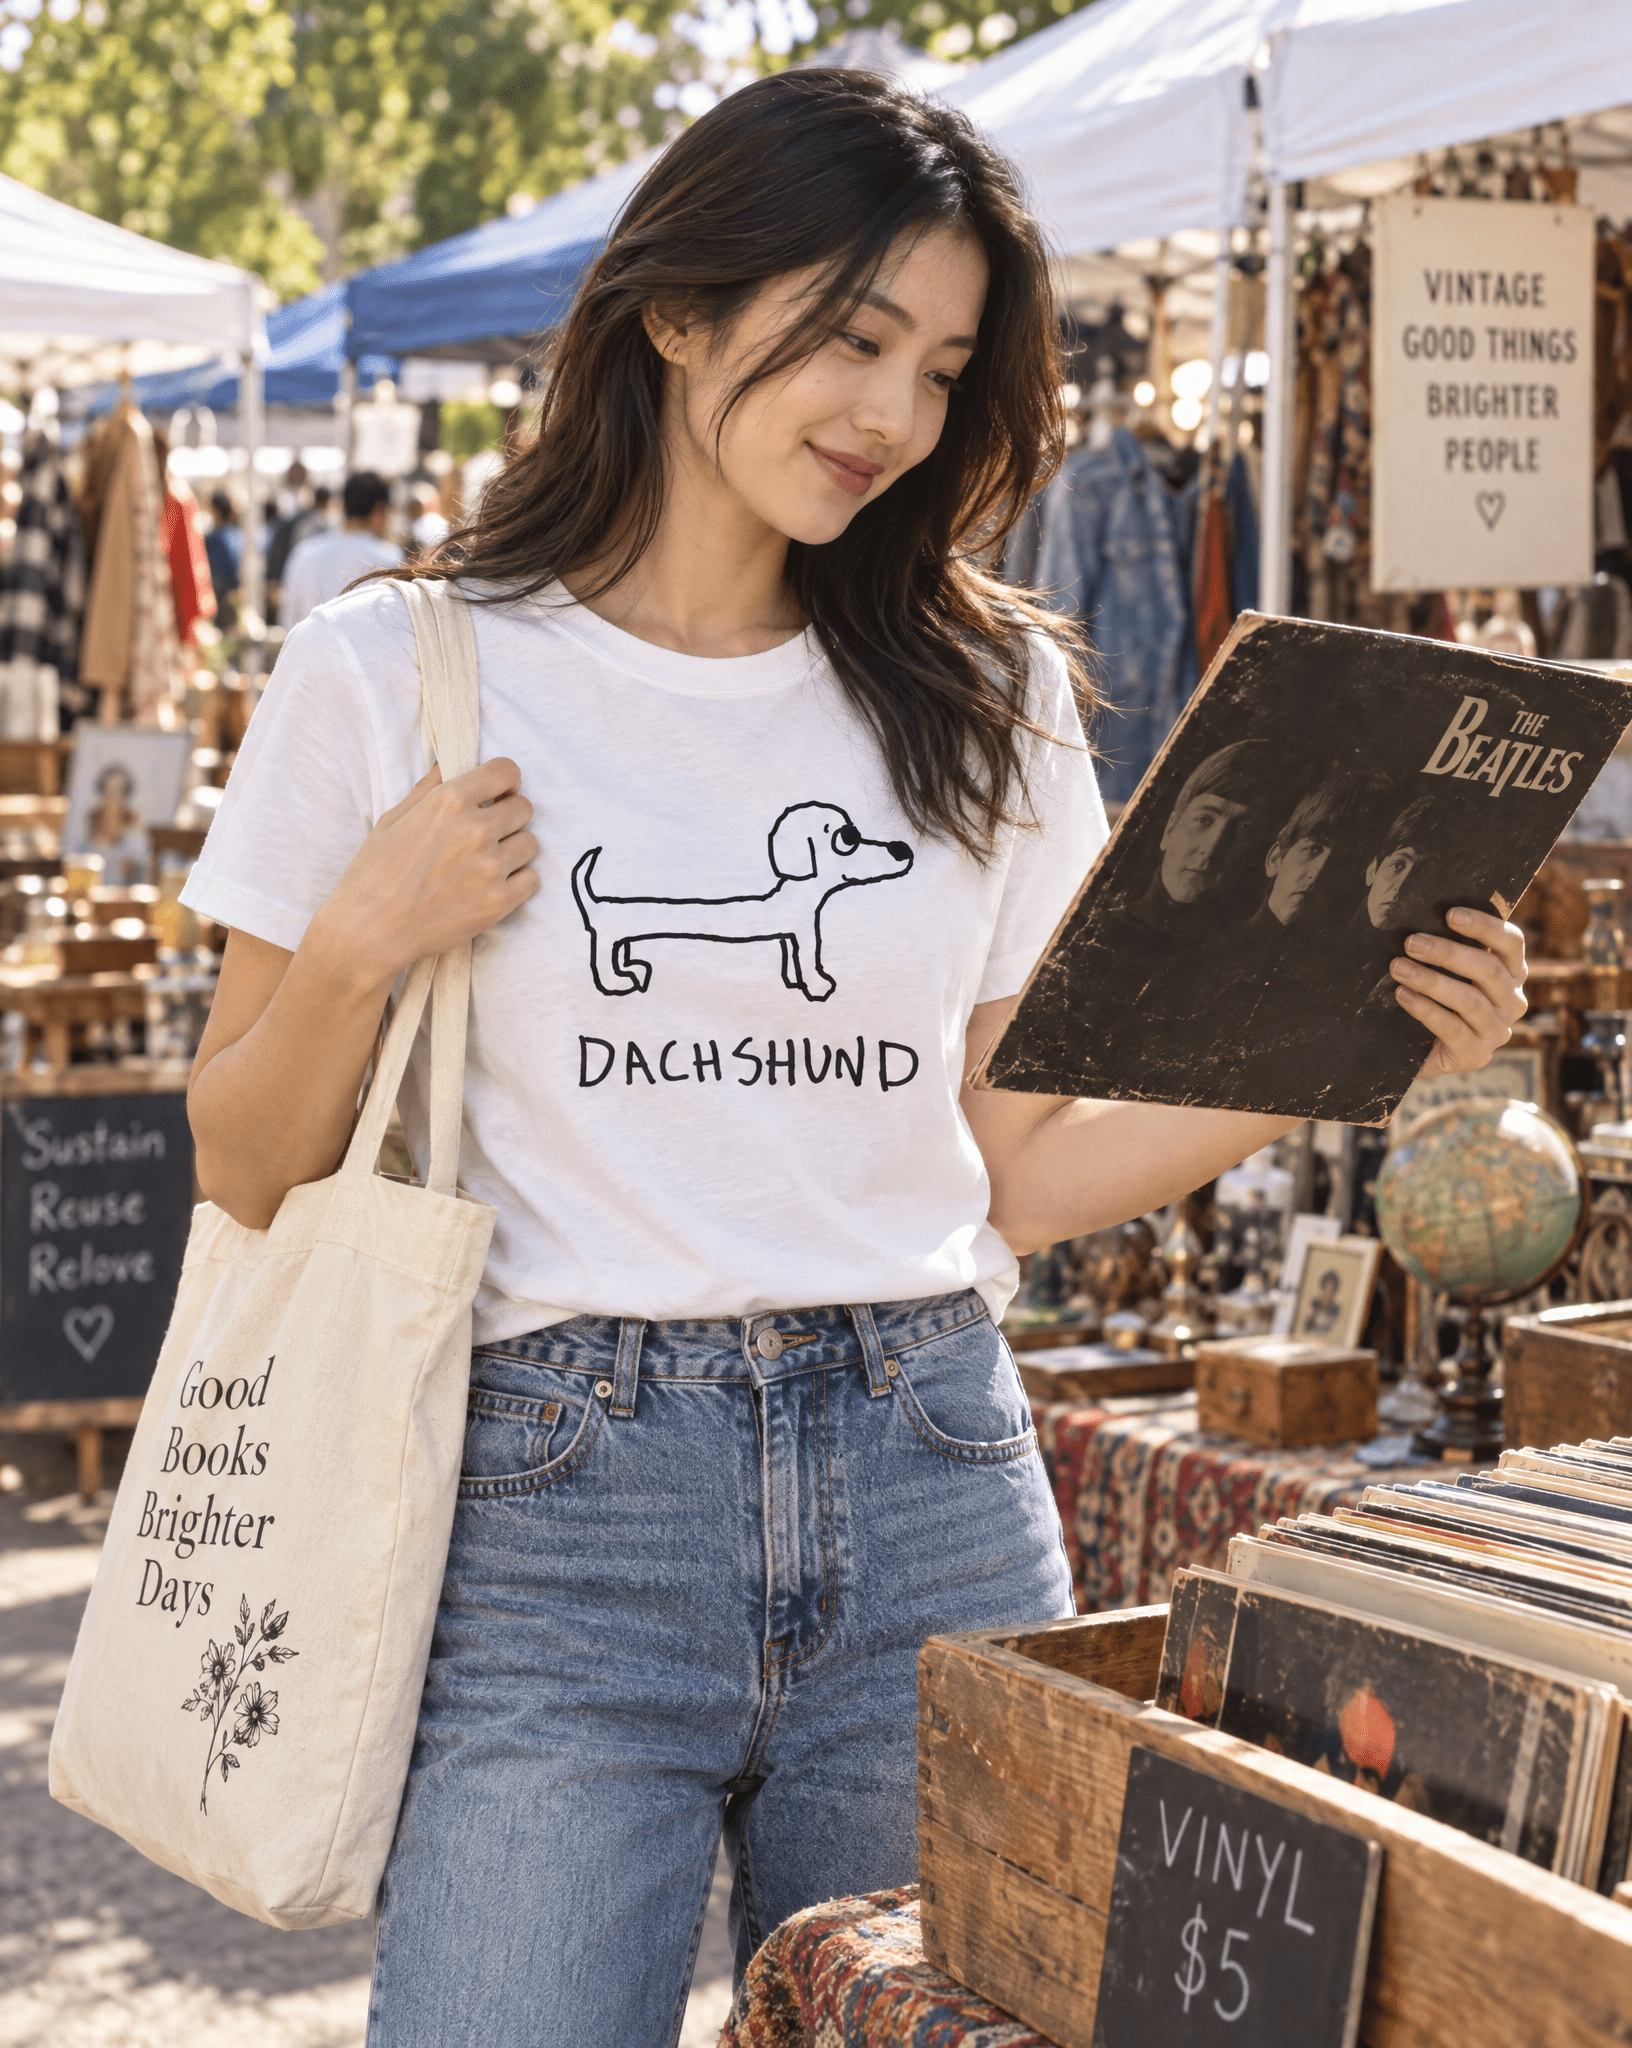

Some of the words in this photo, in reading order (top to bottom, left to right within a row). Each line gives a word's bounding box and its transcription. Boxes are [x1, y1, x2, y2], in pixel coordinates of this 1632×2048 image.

[1424, 270, 1544, 307] VINTAGE
[1402, 324, 1475, 361] GOOD
[1486, 327, 1578, 364] THINGS
[1428, 383, 1559, 419] BRIGHTER
[1446, 437, 1538, 473] PEOPLE
[1420, 695, 1584, 797] BEATLES
[1509, 710, 1550, 737] THE
[579, 1035, 918, 1092] DACHSHUND
[22, 1120, 166, 1170] Sustain
[30, 1181, 144, 1231] Reuse
[30, 1242, 154, 1294] Relove
[181, 1355, 275, 1409] Good
[161, 1425, 269, 1476] Books
[137, 1491, 274, 1559] Brighter
[136, 1559, 214, 1628] Days
[1159, 1799, 1315, 1936] VINYL
[1174, 1903, 1251, 2022] $5
